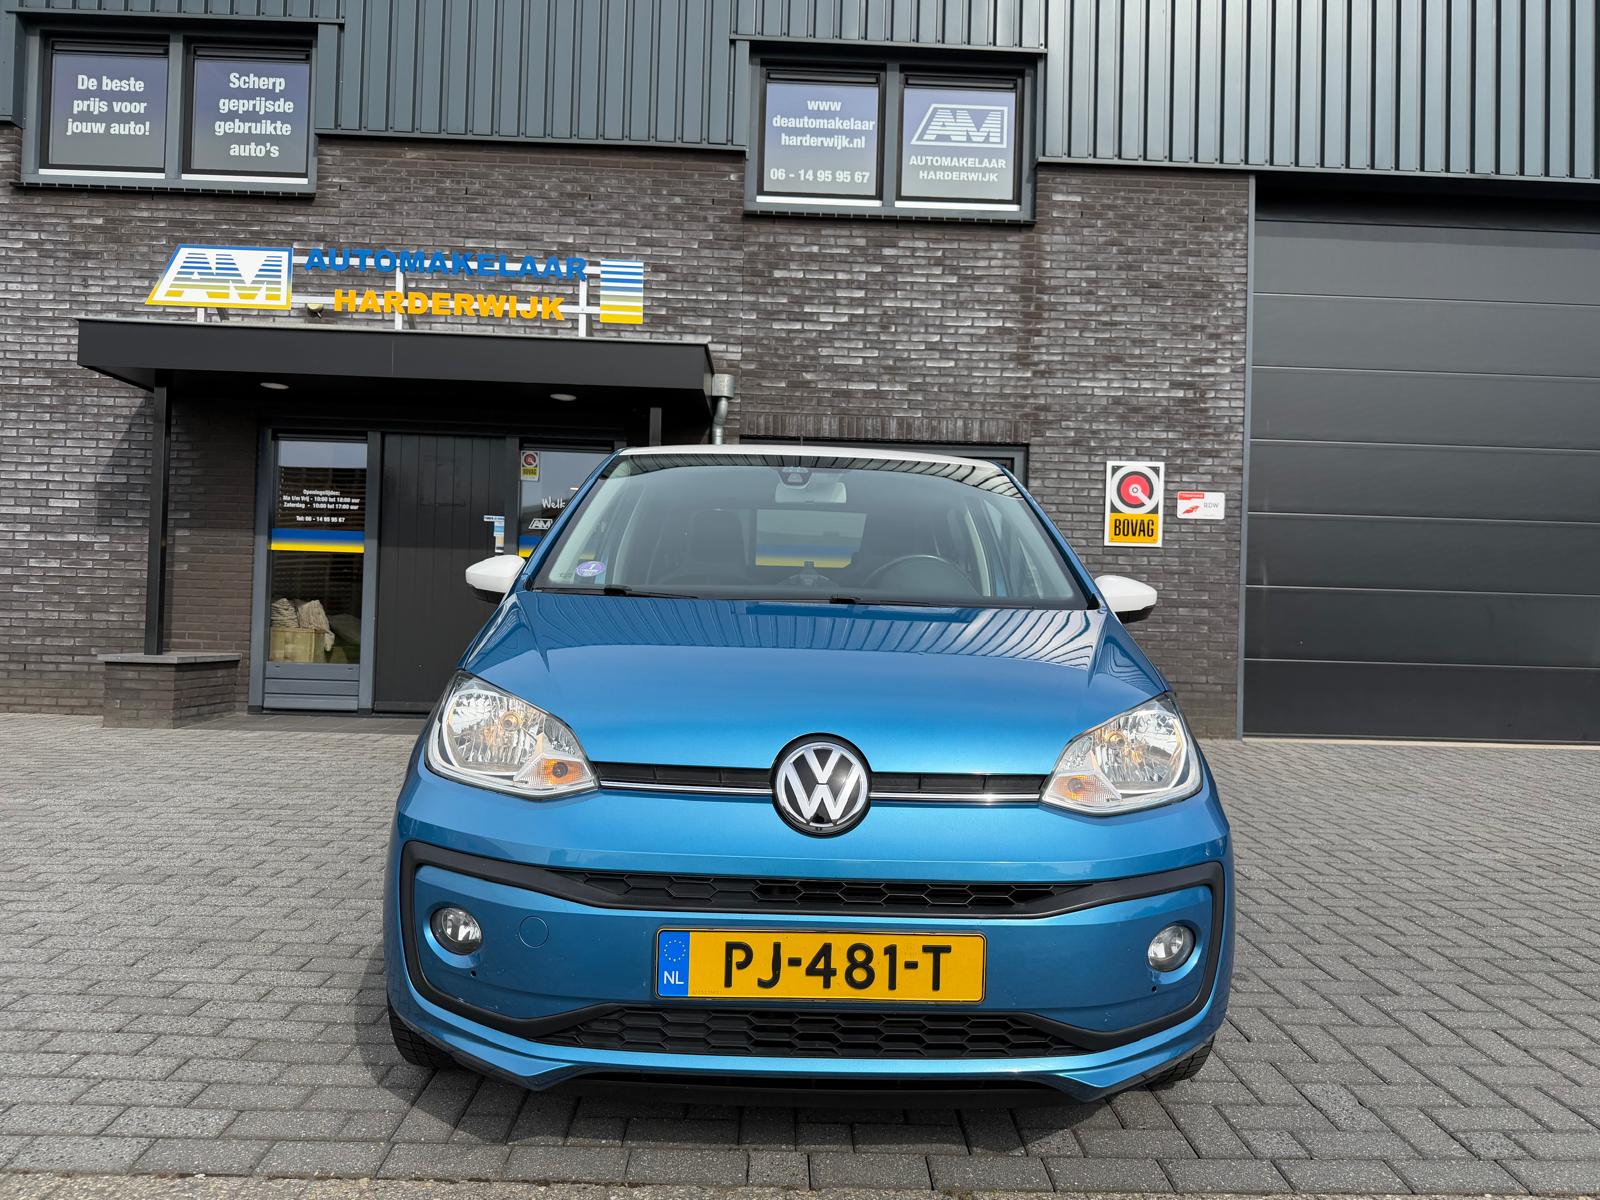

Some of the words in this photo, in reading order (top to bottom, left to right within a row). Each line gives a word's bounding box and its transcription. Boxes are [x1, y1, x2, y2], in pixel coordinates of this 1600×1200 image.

[77, 74, 97, 91] De
[102, 75, 145, 92] beste
[229, 72, 285, 93] Scherp
[73, 98, 108, 114] prijs
[113, 101, 147, 114] voor
[219, 97, 294, 115] geprijsde
[806, 100, 842, 112] www
[66, 118, 106, 136] jouw
[110, 120, 150, 136] auto!
[214, 119, 292, 136] gebruikte
[772, 115, 876, 131] deautomakelaar
[229, 142, 280, 158] auto's
[781, 133, 866, 150] harderwijk.nl
[909, 155, 1007, 169] AUTOMAKELAAR
[770, 167, 786, 180] 06
[799, 168, 815, 181] 14
[816, 169, 833, 182] 95
[835, 170, 852, 183] 95
[854, 171, 870, 184] 67
[919, 170, 999, 183] HARDERWIJK
[304, 247, 588, 281] AUTOMAKELAAR
[333, 288, 566, 321] HARDERWIJK
[1113, 518, 1155, 538] BOVAG
[724, 941, 952, 991] PJ-481-T
[663, 970, 684, 985] NL
